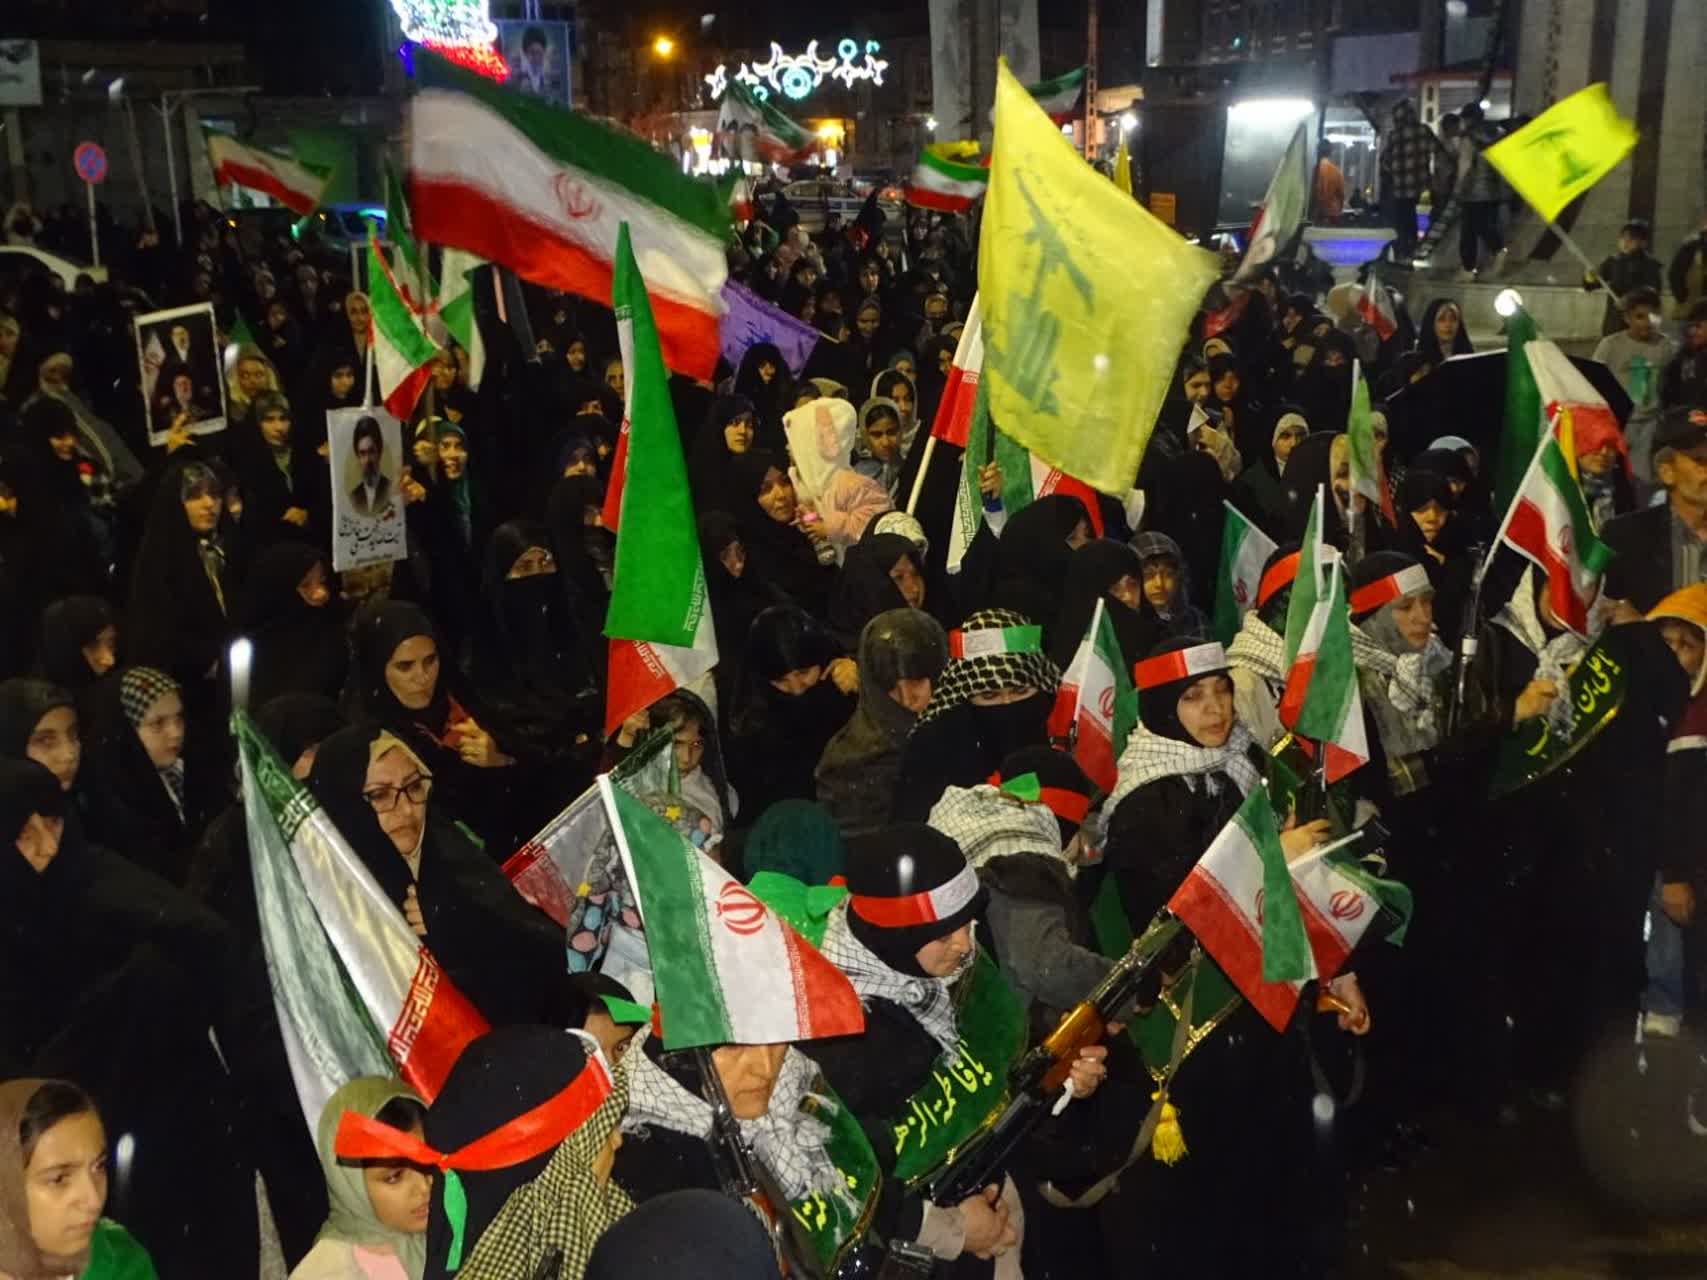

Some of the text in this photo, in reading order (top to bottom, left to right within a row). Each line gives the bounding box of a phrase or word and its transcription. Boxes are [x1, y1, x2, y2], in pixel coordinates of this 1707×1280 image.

[1585, 655, 1612, 694] علی
[1576, 680, 1600, 714] بن
[957, 1039, 993, 1087] یا
[893, 1099, 940, 1156] الزهر
